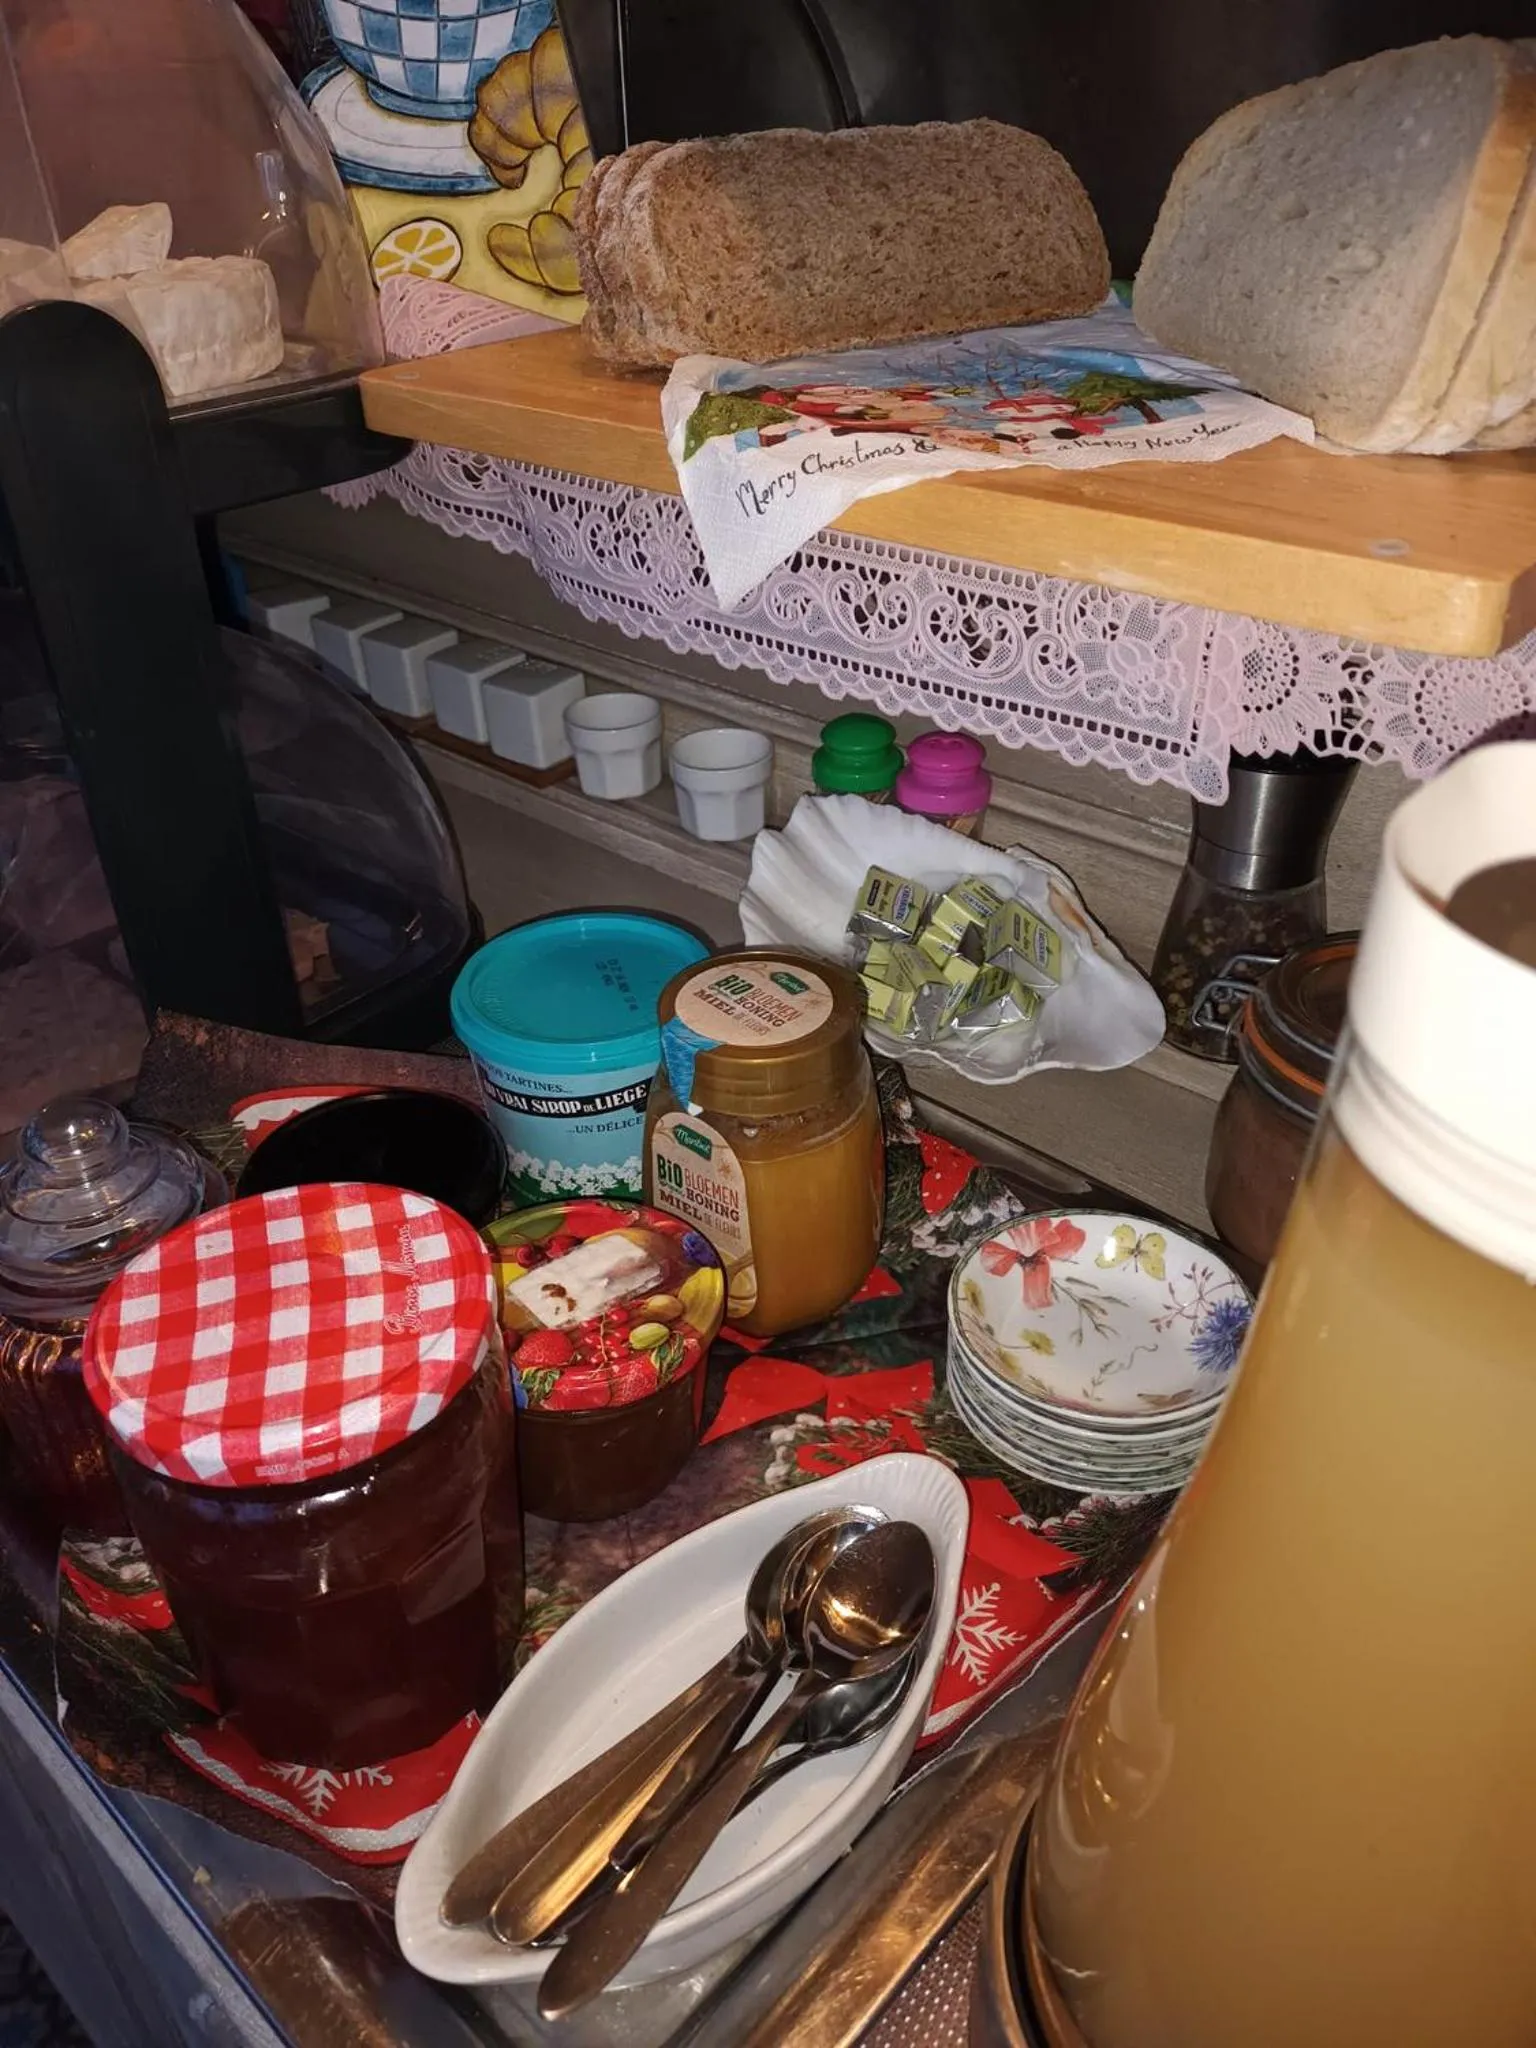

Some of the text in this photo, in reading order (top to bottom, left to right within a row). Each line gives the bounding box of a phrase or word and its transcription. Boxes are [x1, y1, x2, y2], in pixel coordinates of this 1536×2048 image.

[735, 469, 797, 518] Merry
[800, 440, 906, 475] Christmas
[692, 988, 738, 1017] MIEL
[732, 996, 786, 1028] HONING
[745, 987, 804, 1022] BLOEMEN
[530, 1098, 582, 1115] SIROP
[659, 1189, 703, 1221] MIEL
[684, 1167, 740, 1210] BLOEMEN
[686, 1188, 741, 1223] HONING
